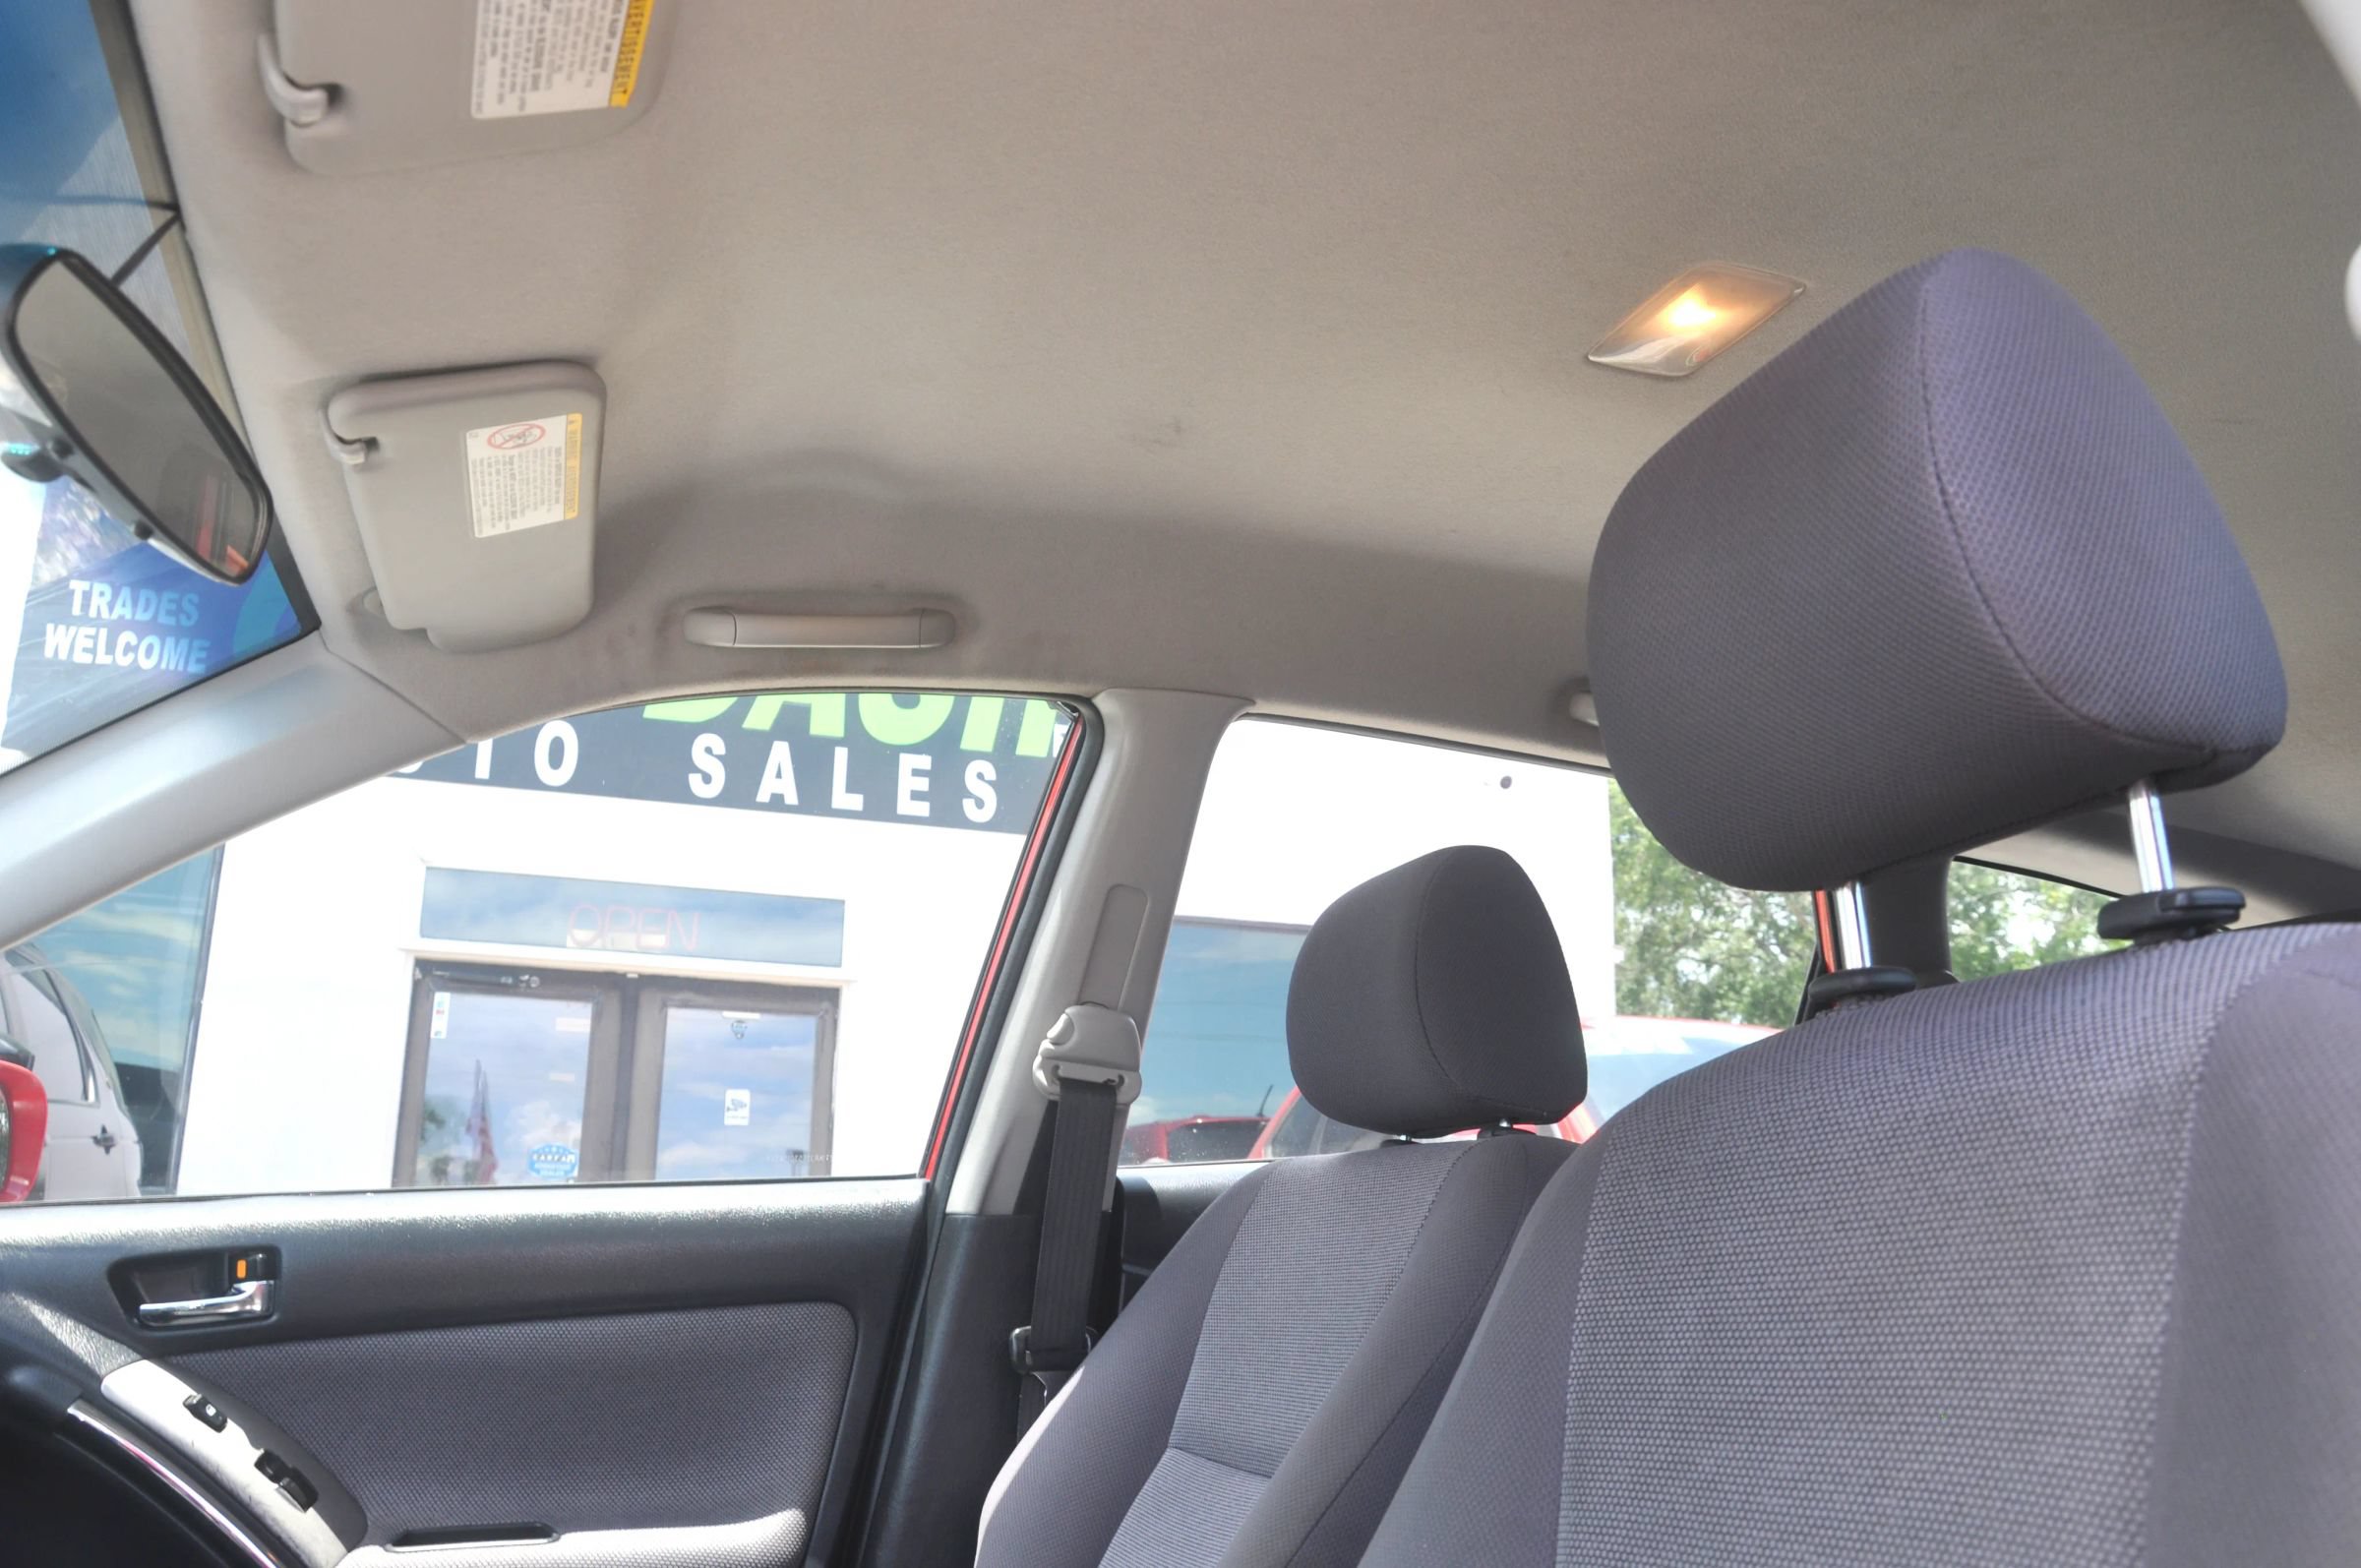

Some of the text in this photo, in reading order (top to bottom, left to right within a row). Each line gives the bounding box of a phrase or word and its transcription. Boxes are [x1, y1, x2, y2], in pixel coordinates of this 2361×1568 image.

[69, 578, 200, 628] TRADES
[43, 623, 211, 675] WELCOME
[688, 732, 999, 823] SALES
[569, 903, 700, 951] OPEN
